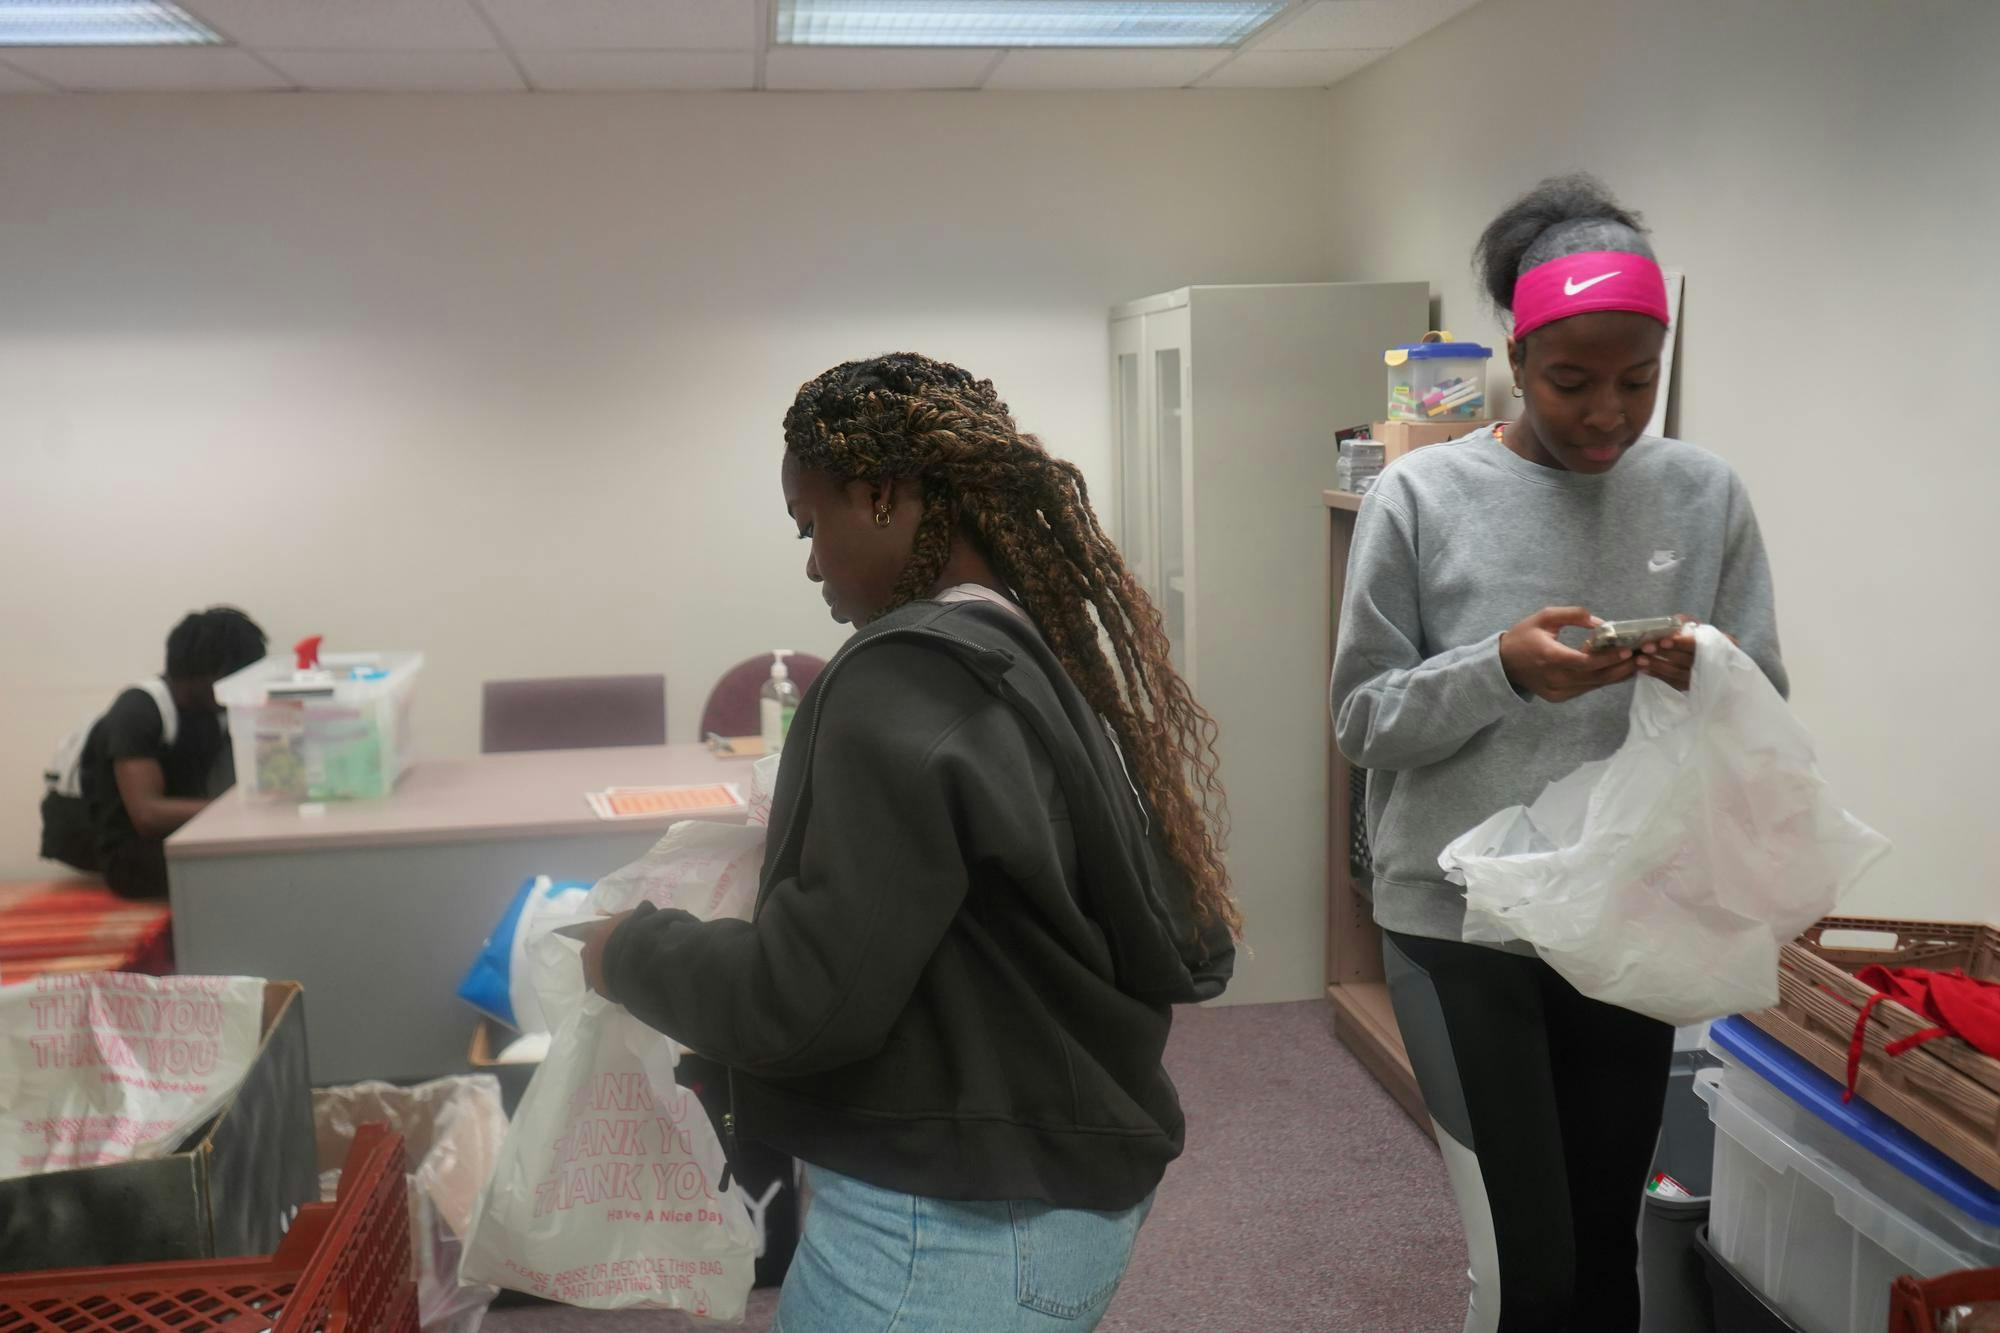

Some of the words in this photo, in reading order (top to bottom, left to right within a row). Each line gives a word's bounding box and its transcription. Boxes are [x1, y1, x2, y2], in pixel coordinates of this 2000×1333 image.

[29, 994, 146, 1032] THANK
[149, 997, 222, 1036] YOU
[29, 1034, 142, 1070] THANK
[146, 1038, 218, 1076] YOU
[607, 1209, 641, 1222] Have
[644, 1209, 655, 1222] A
[660, 1209, 693, 1223] Nice
[698, 1208, 724, 1225] Day
[504, 1258, 551, 1284] PLEASE
[591, 1263, 608, 1280] OR
[611, 1258, 665, 1277] RECYCLE
[668, 1258, 696, 1274] THIS
[699, 1260, 724, 1276] BAG
[562, 1276, 652, 1299] PARTICIPATING
[656, 1274, 694, 1290] STORE
